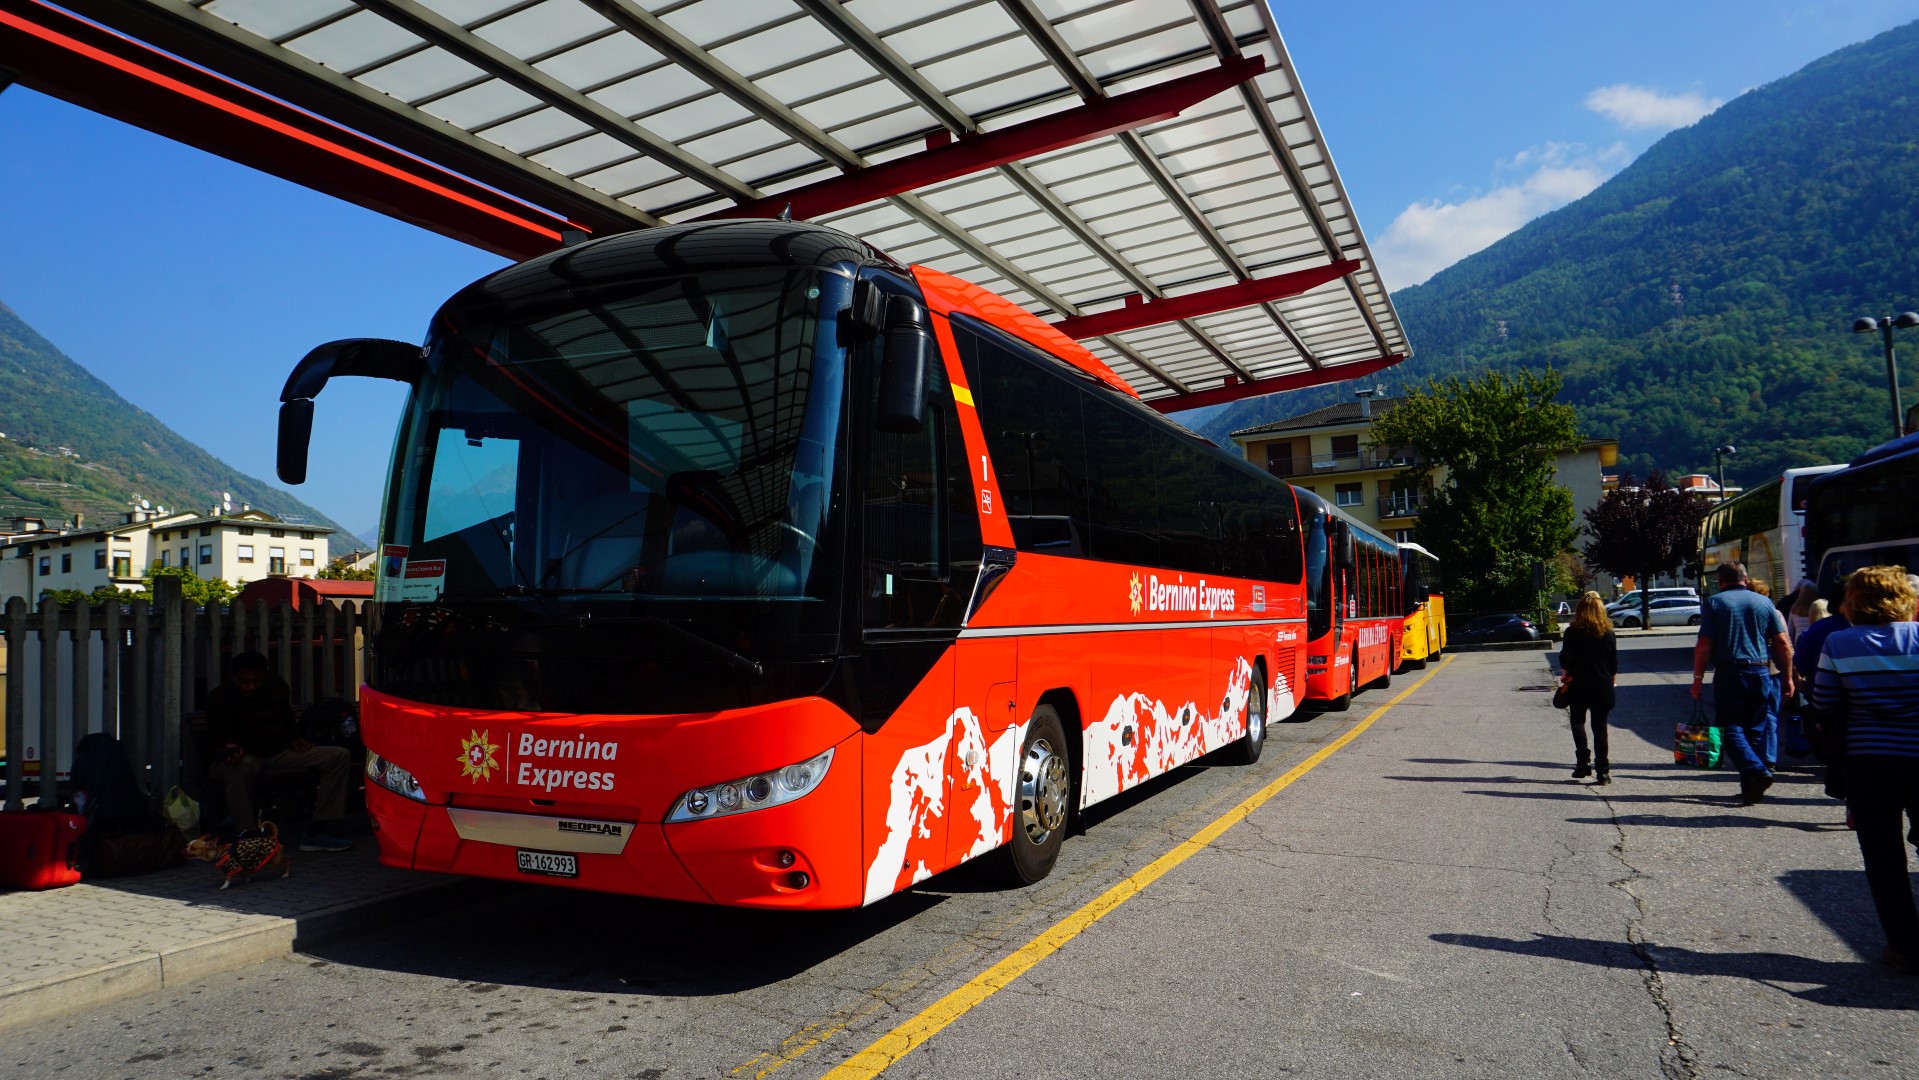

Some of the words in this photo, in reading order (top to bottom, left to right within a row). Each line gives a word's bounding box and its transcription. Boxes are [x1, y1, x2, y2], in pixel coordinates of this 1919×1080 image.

[981, 455, 988, 482] 1
[1149, 573, 1197, 612] Bernina
[1199, 579, 1236, 619] Express
[517, 732, 618, 761] Bernina
[517, 762, 615, 793] Express
[558, 821, 622, 835] NEOPLAN
